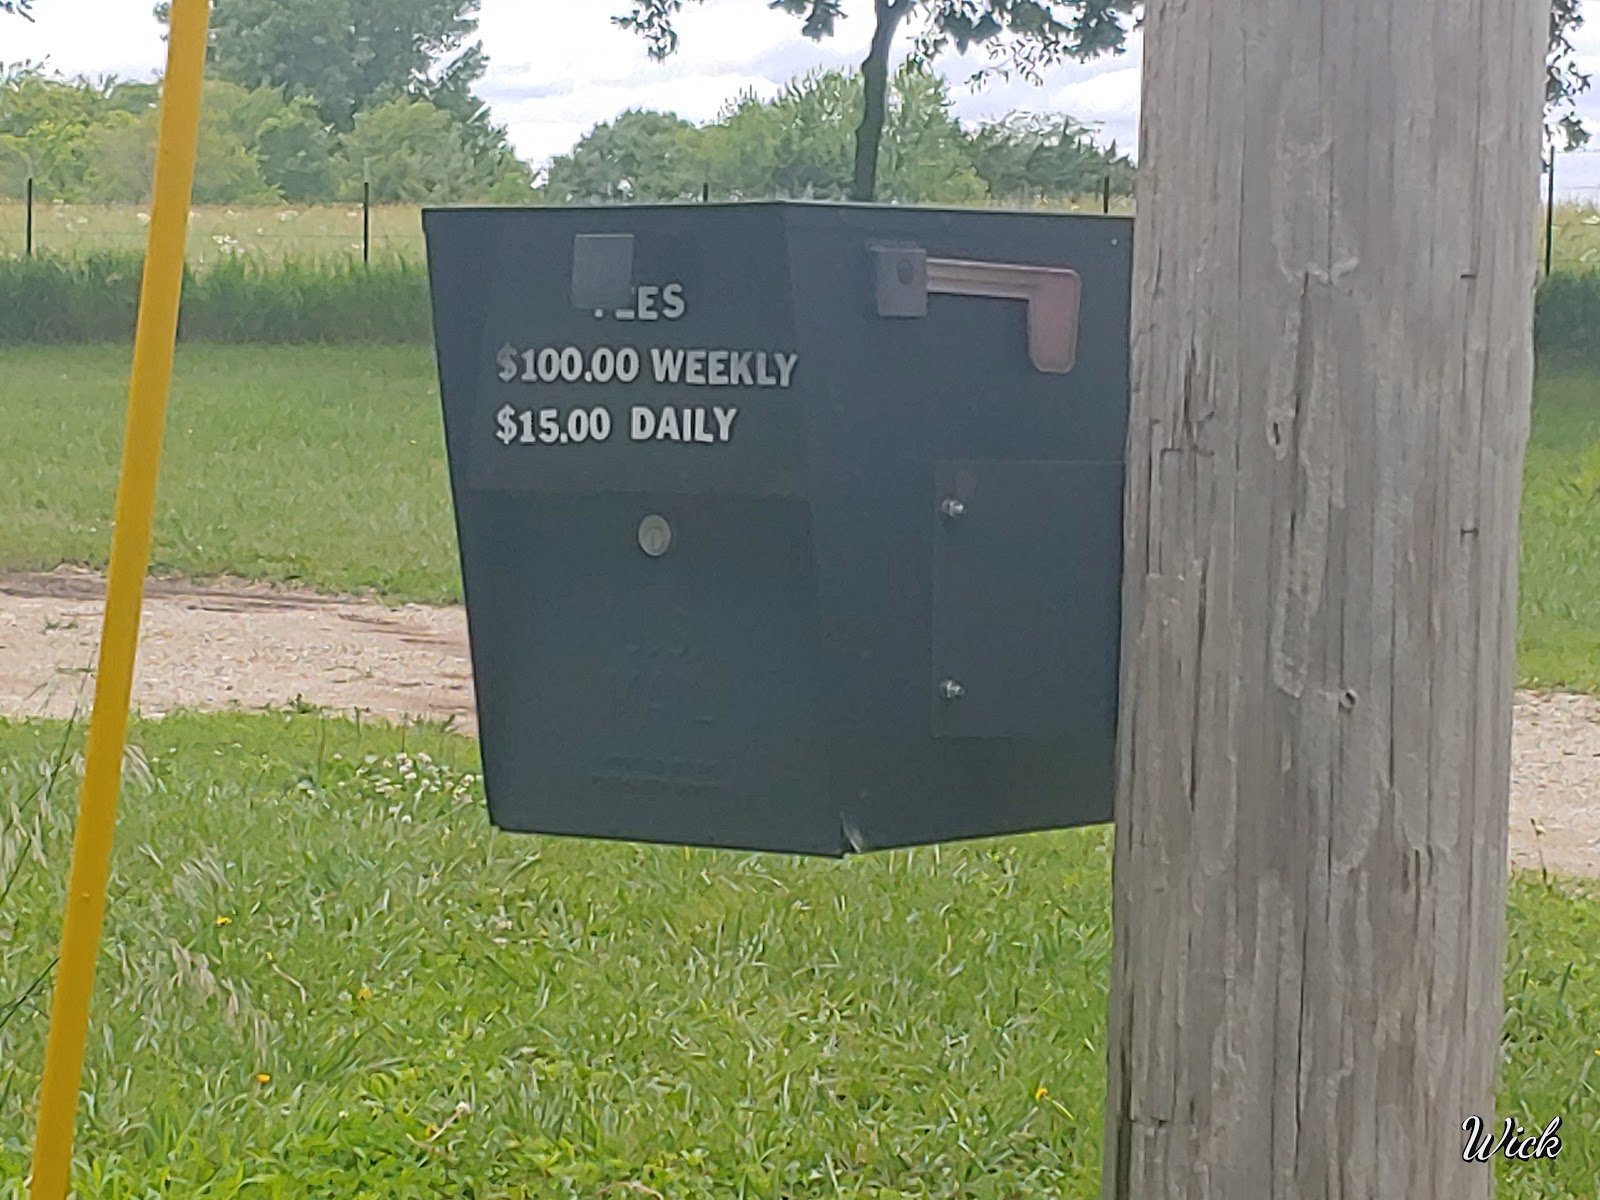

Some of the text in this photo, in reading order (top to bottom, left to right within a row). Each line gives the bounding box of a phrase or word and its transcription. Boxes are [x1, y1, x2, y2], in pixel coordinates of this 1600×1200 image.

[594, 283, 687, 321] ES
[496, 343, 798, 387] $100.00 WEEKLY
[496, 403, 737, 445] $15.00 DAILY
